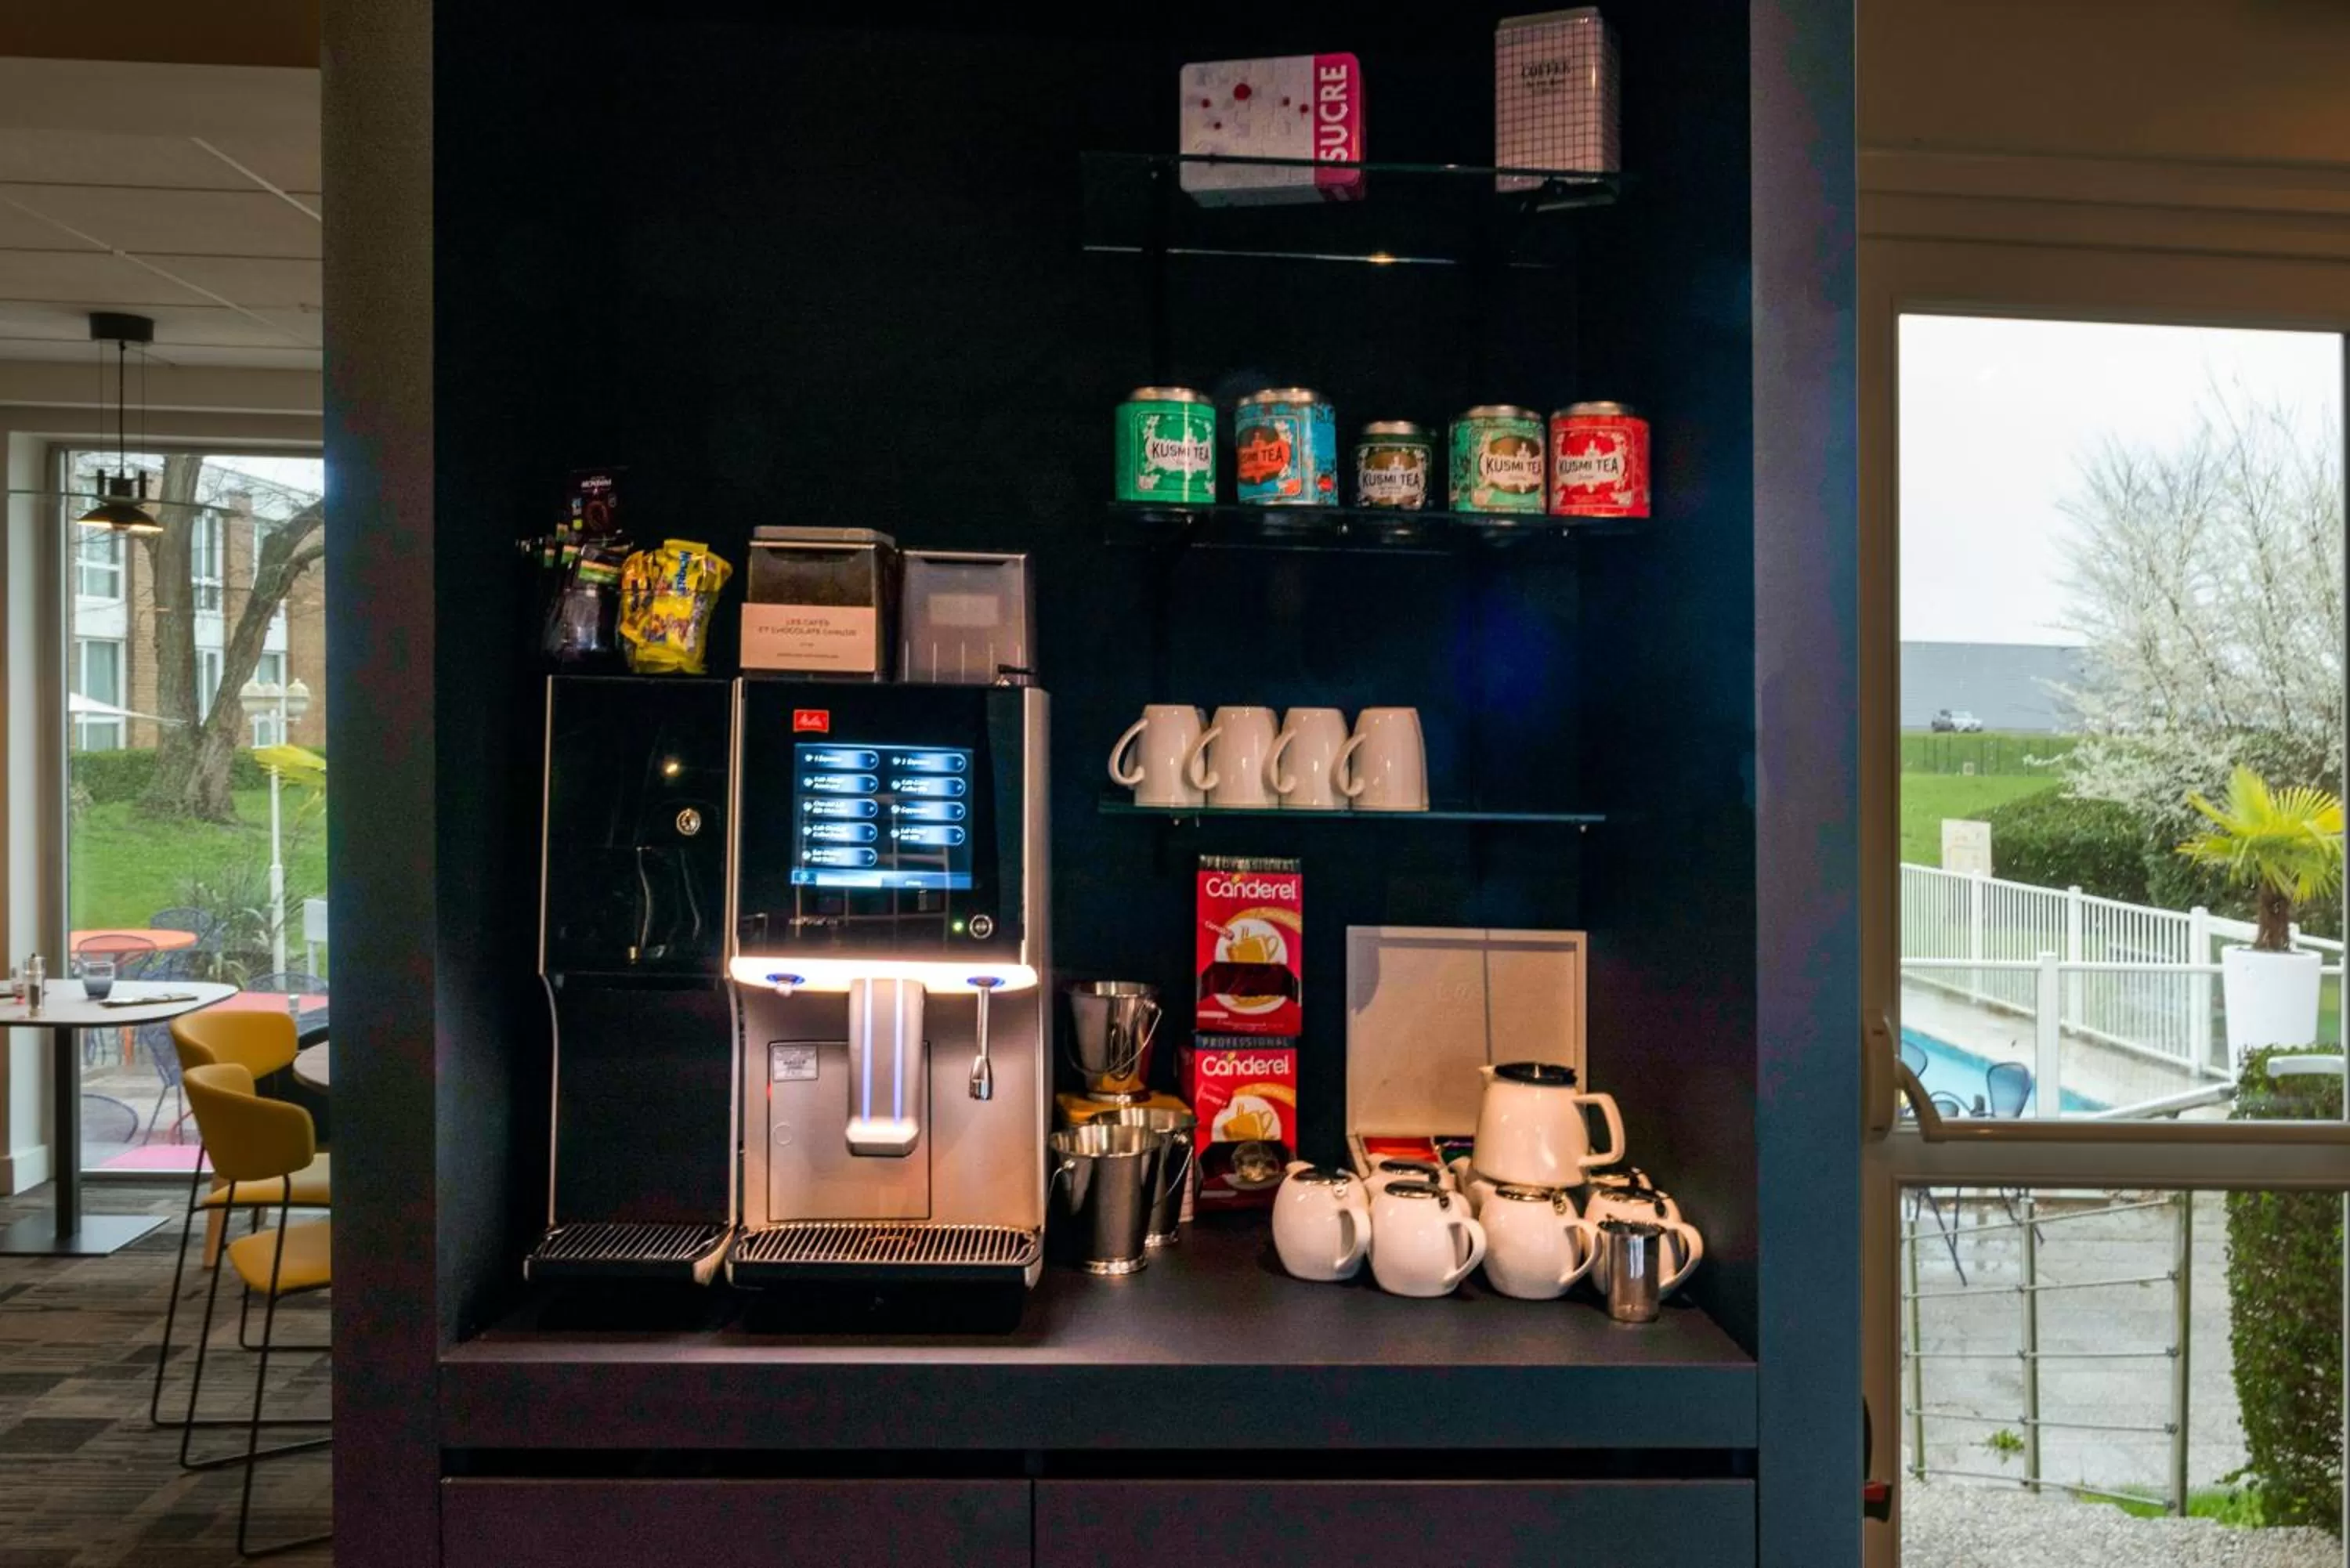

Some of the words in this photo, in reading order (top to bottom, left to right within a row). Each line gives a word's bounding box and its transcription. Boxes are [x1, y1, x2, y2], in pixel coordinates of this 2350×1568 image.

[1319, 64, 1349, 162] SUCRE
[1152, 442, 1190, 458] KUSMI
[1194, 446, 1210, 463] TEA
[1260, 445, 1284, 463] TEA
[1486, 457, 1524, 475] KUSMI
[1559, 457, 1593, 473] KUSMI
[1595, 458, 1618, 474] TEA
[1361, 472, 1397, 487] KUSMI
[1399, 472, 1421, 488] TEA
[1205, 876, 1297, 900] Canderel
[1202, 1055, 1291, 1076] Canderel
